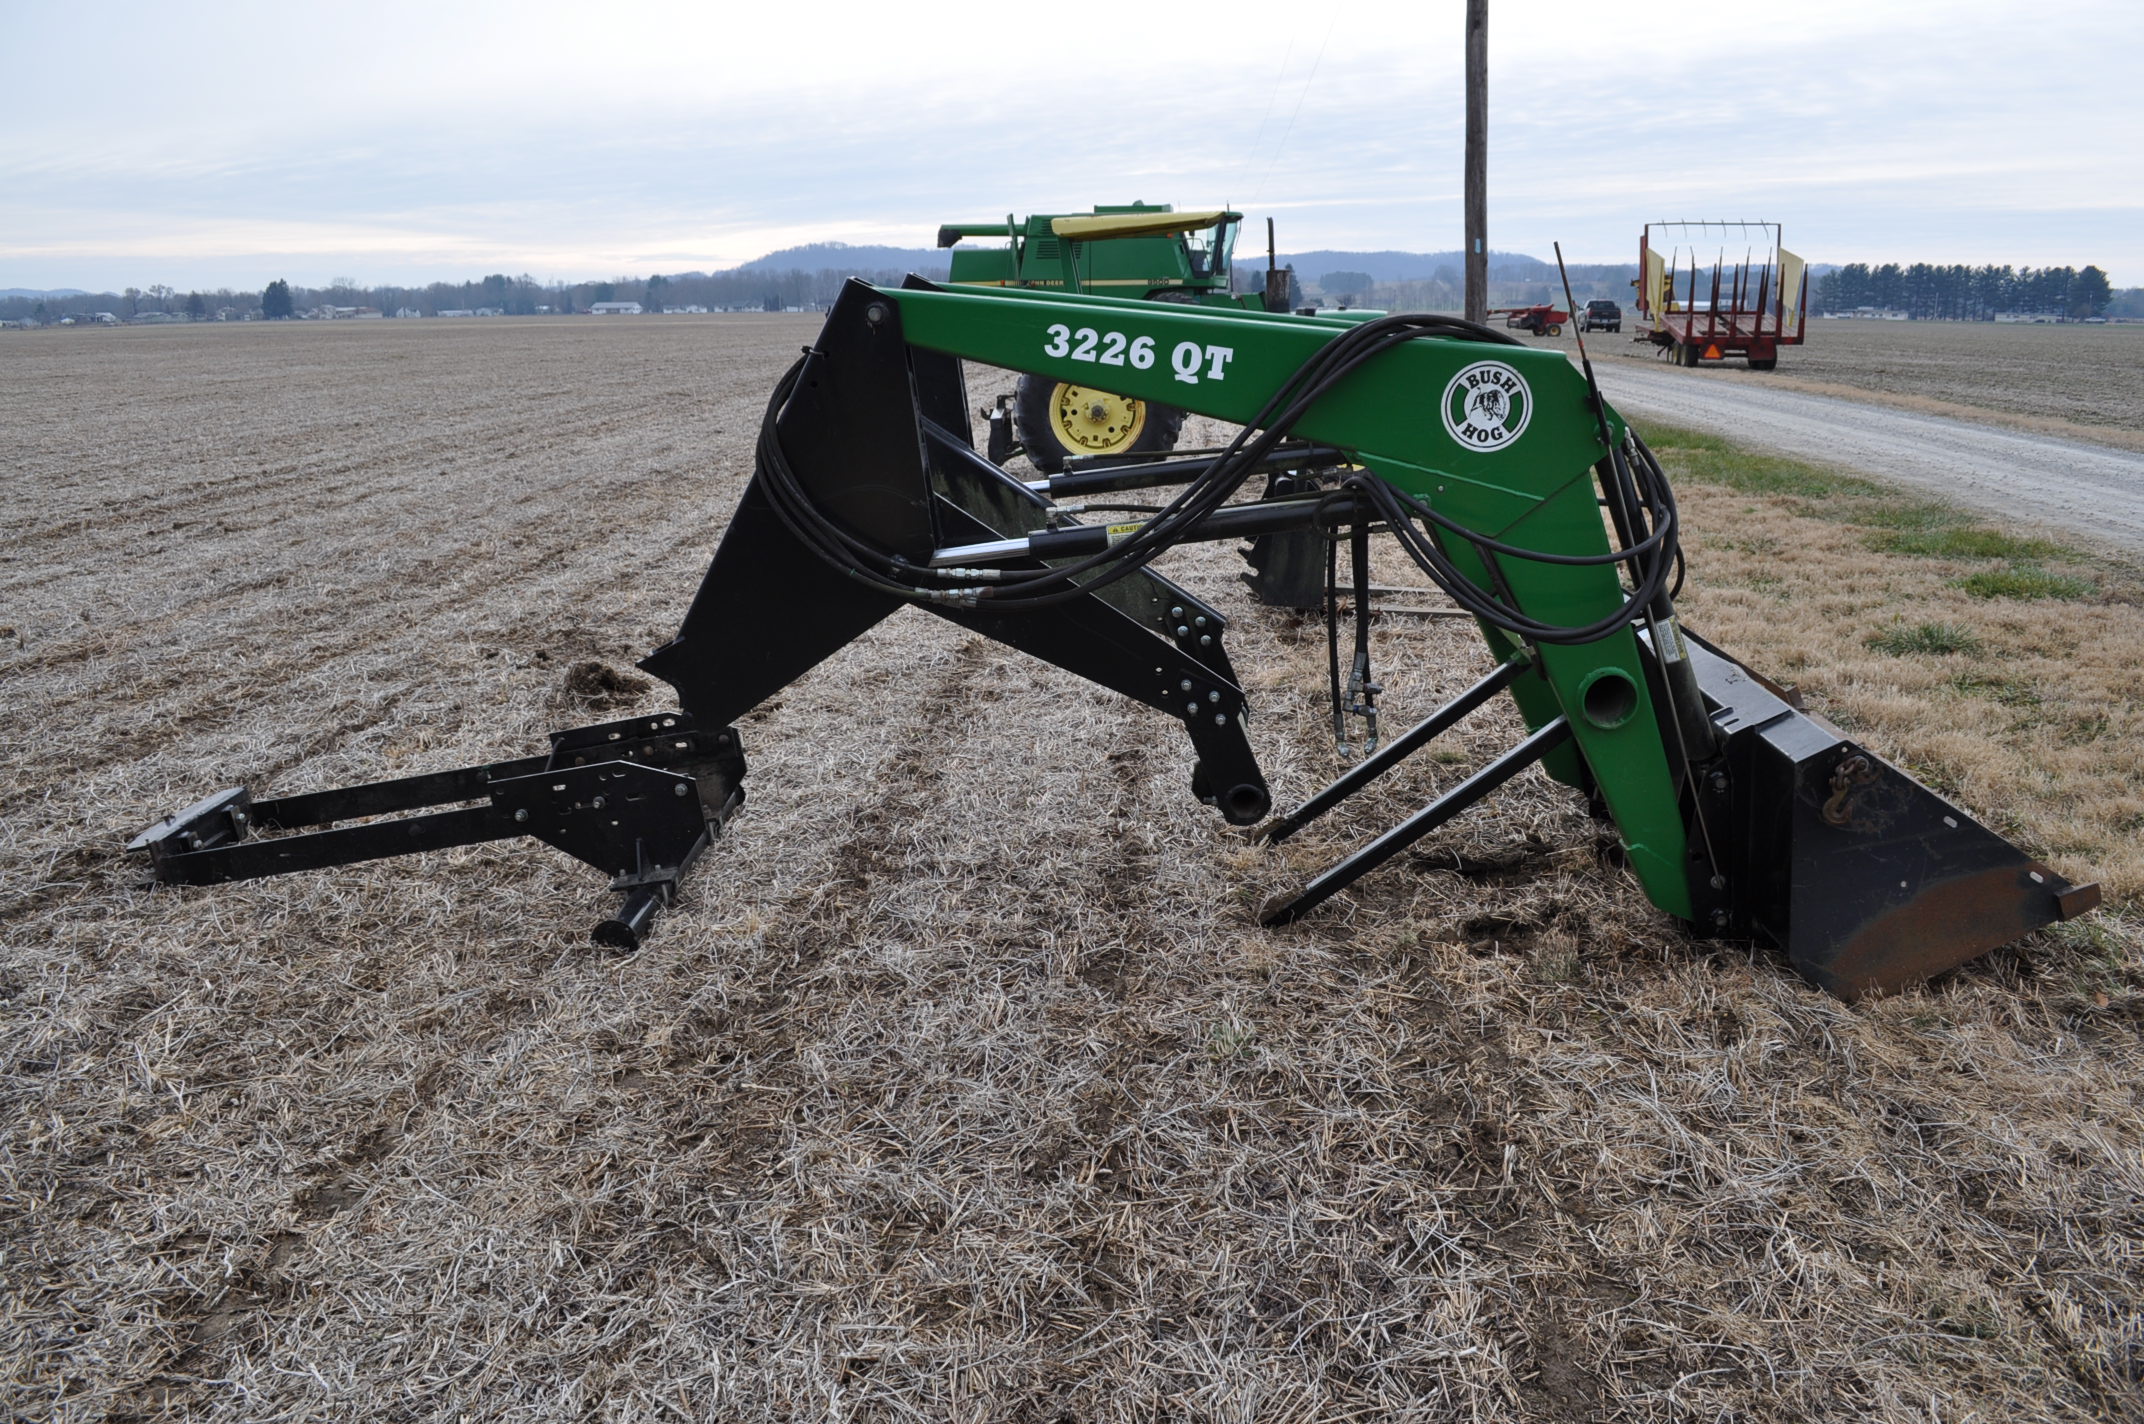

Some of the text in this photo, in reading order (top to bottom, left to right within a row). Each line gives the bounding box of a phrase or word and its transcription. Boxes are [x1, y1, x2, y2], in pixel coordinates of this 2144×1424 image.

[1044, 323, 1234, 384] 3226 QT
[1465, 370, 1517, 394] BUSH
[1461, 423, 1503, 443] HOG
